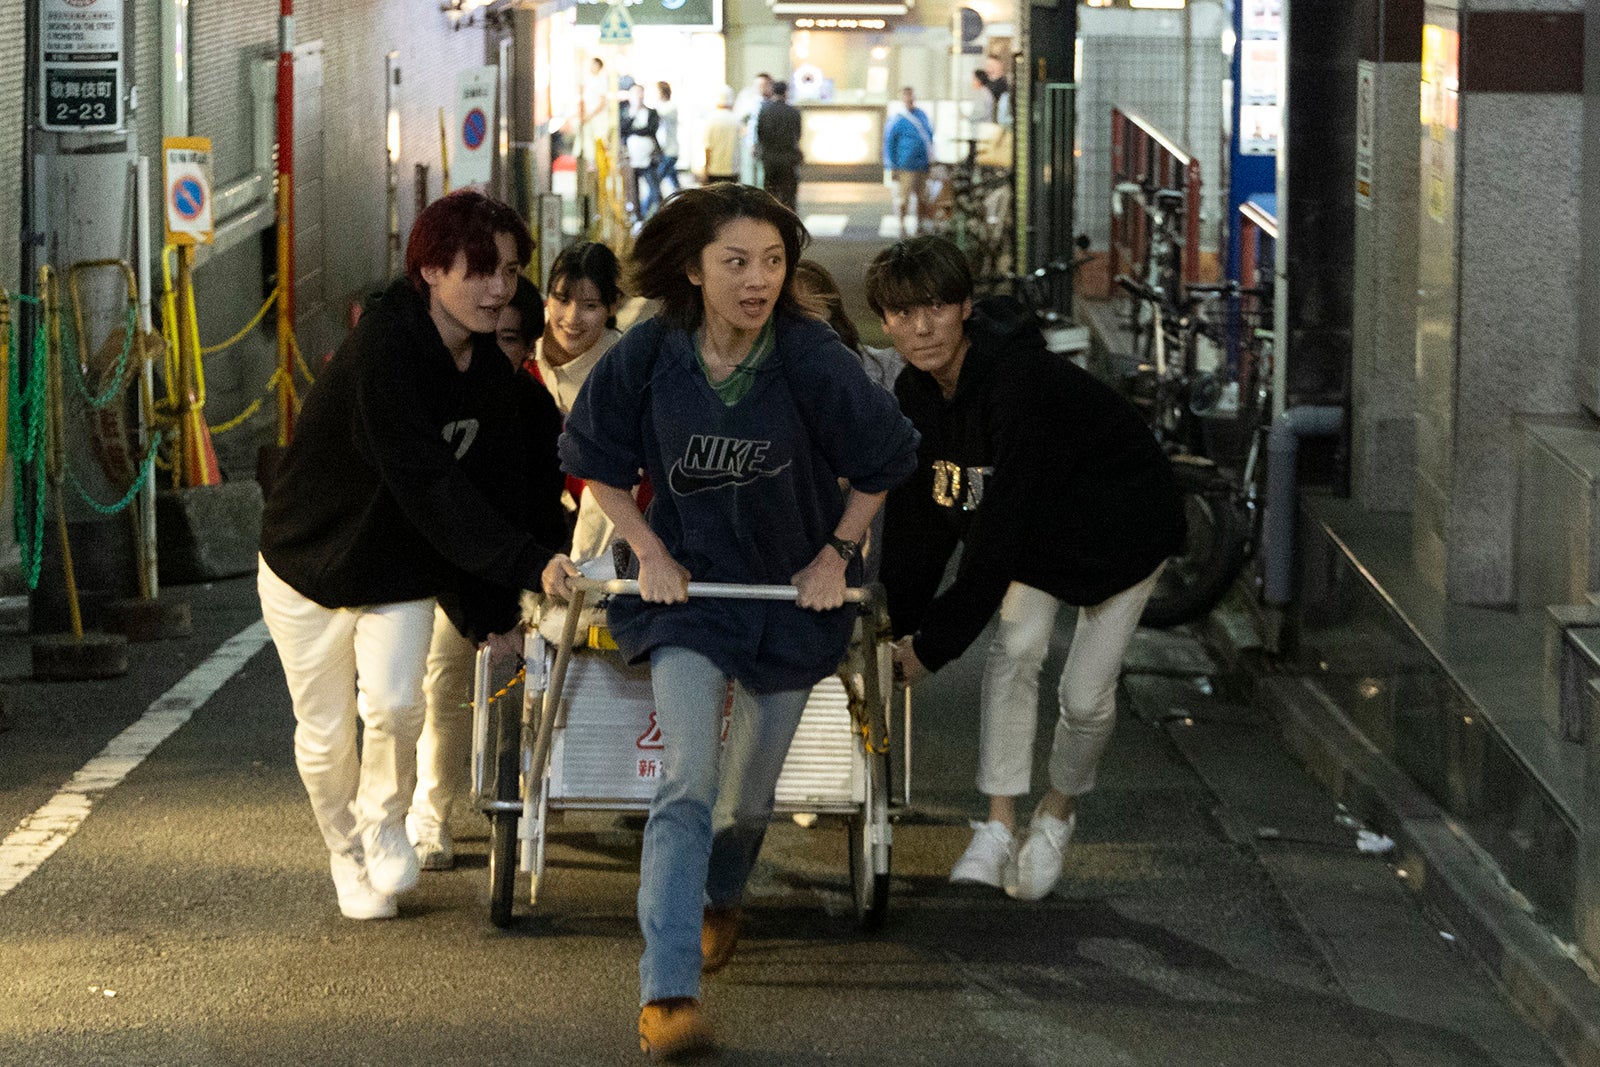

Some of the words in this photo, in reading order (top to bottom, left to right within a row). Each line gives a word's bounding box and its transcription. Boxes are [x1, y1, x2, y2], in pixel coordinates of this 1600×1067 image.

[50, 81, 112, 99] 歌舞伎町
[56, 102, 107, 120] 2-23
[684, 434, 772, 476] NIKE
[638, 758, 663, 778] 新
